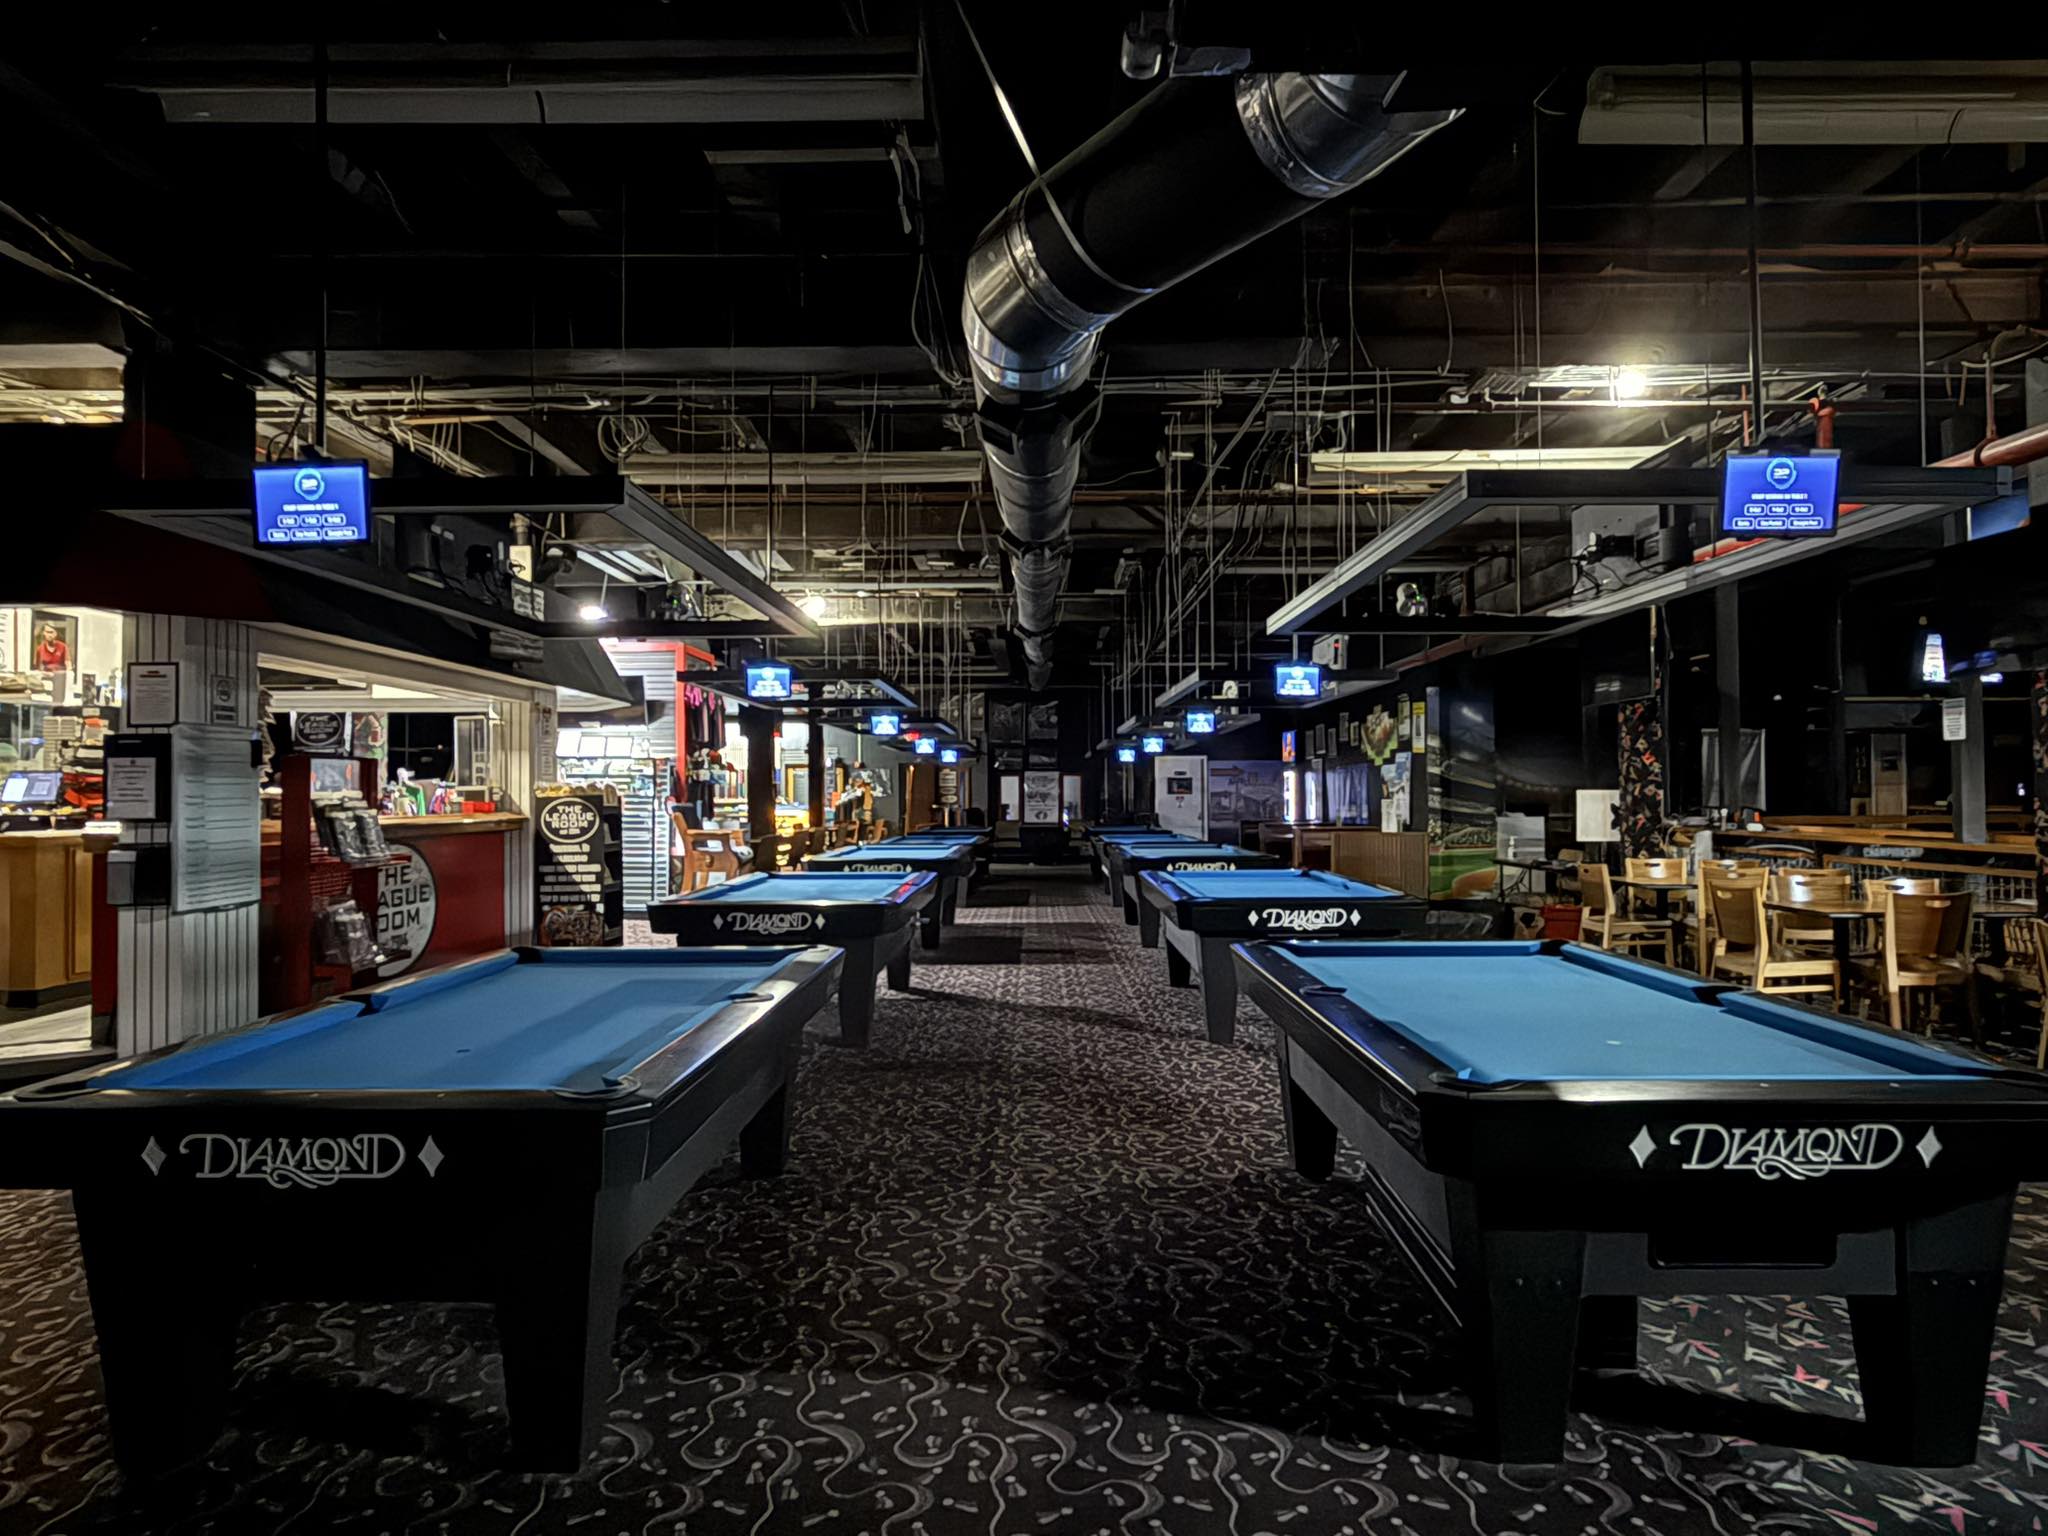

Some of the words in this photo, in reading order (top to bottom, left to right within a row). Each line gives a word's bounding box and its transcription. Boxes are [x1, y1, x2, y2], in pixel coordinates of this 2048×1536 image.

[545, 812, 594, 821] LEAGUE
[556, 805, 582, 814] THE
[378, 885, 431, 908] AGUE
[727, 912, 812, 934] DIAMOND
[1262, 907, 1348, 931] DIAMOND
[178, 1133, 406, 1189] DIAMOND
[1669, 1124, 1903, 1180] DIAMOND
